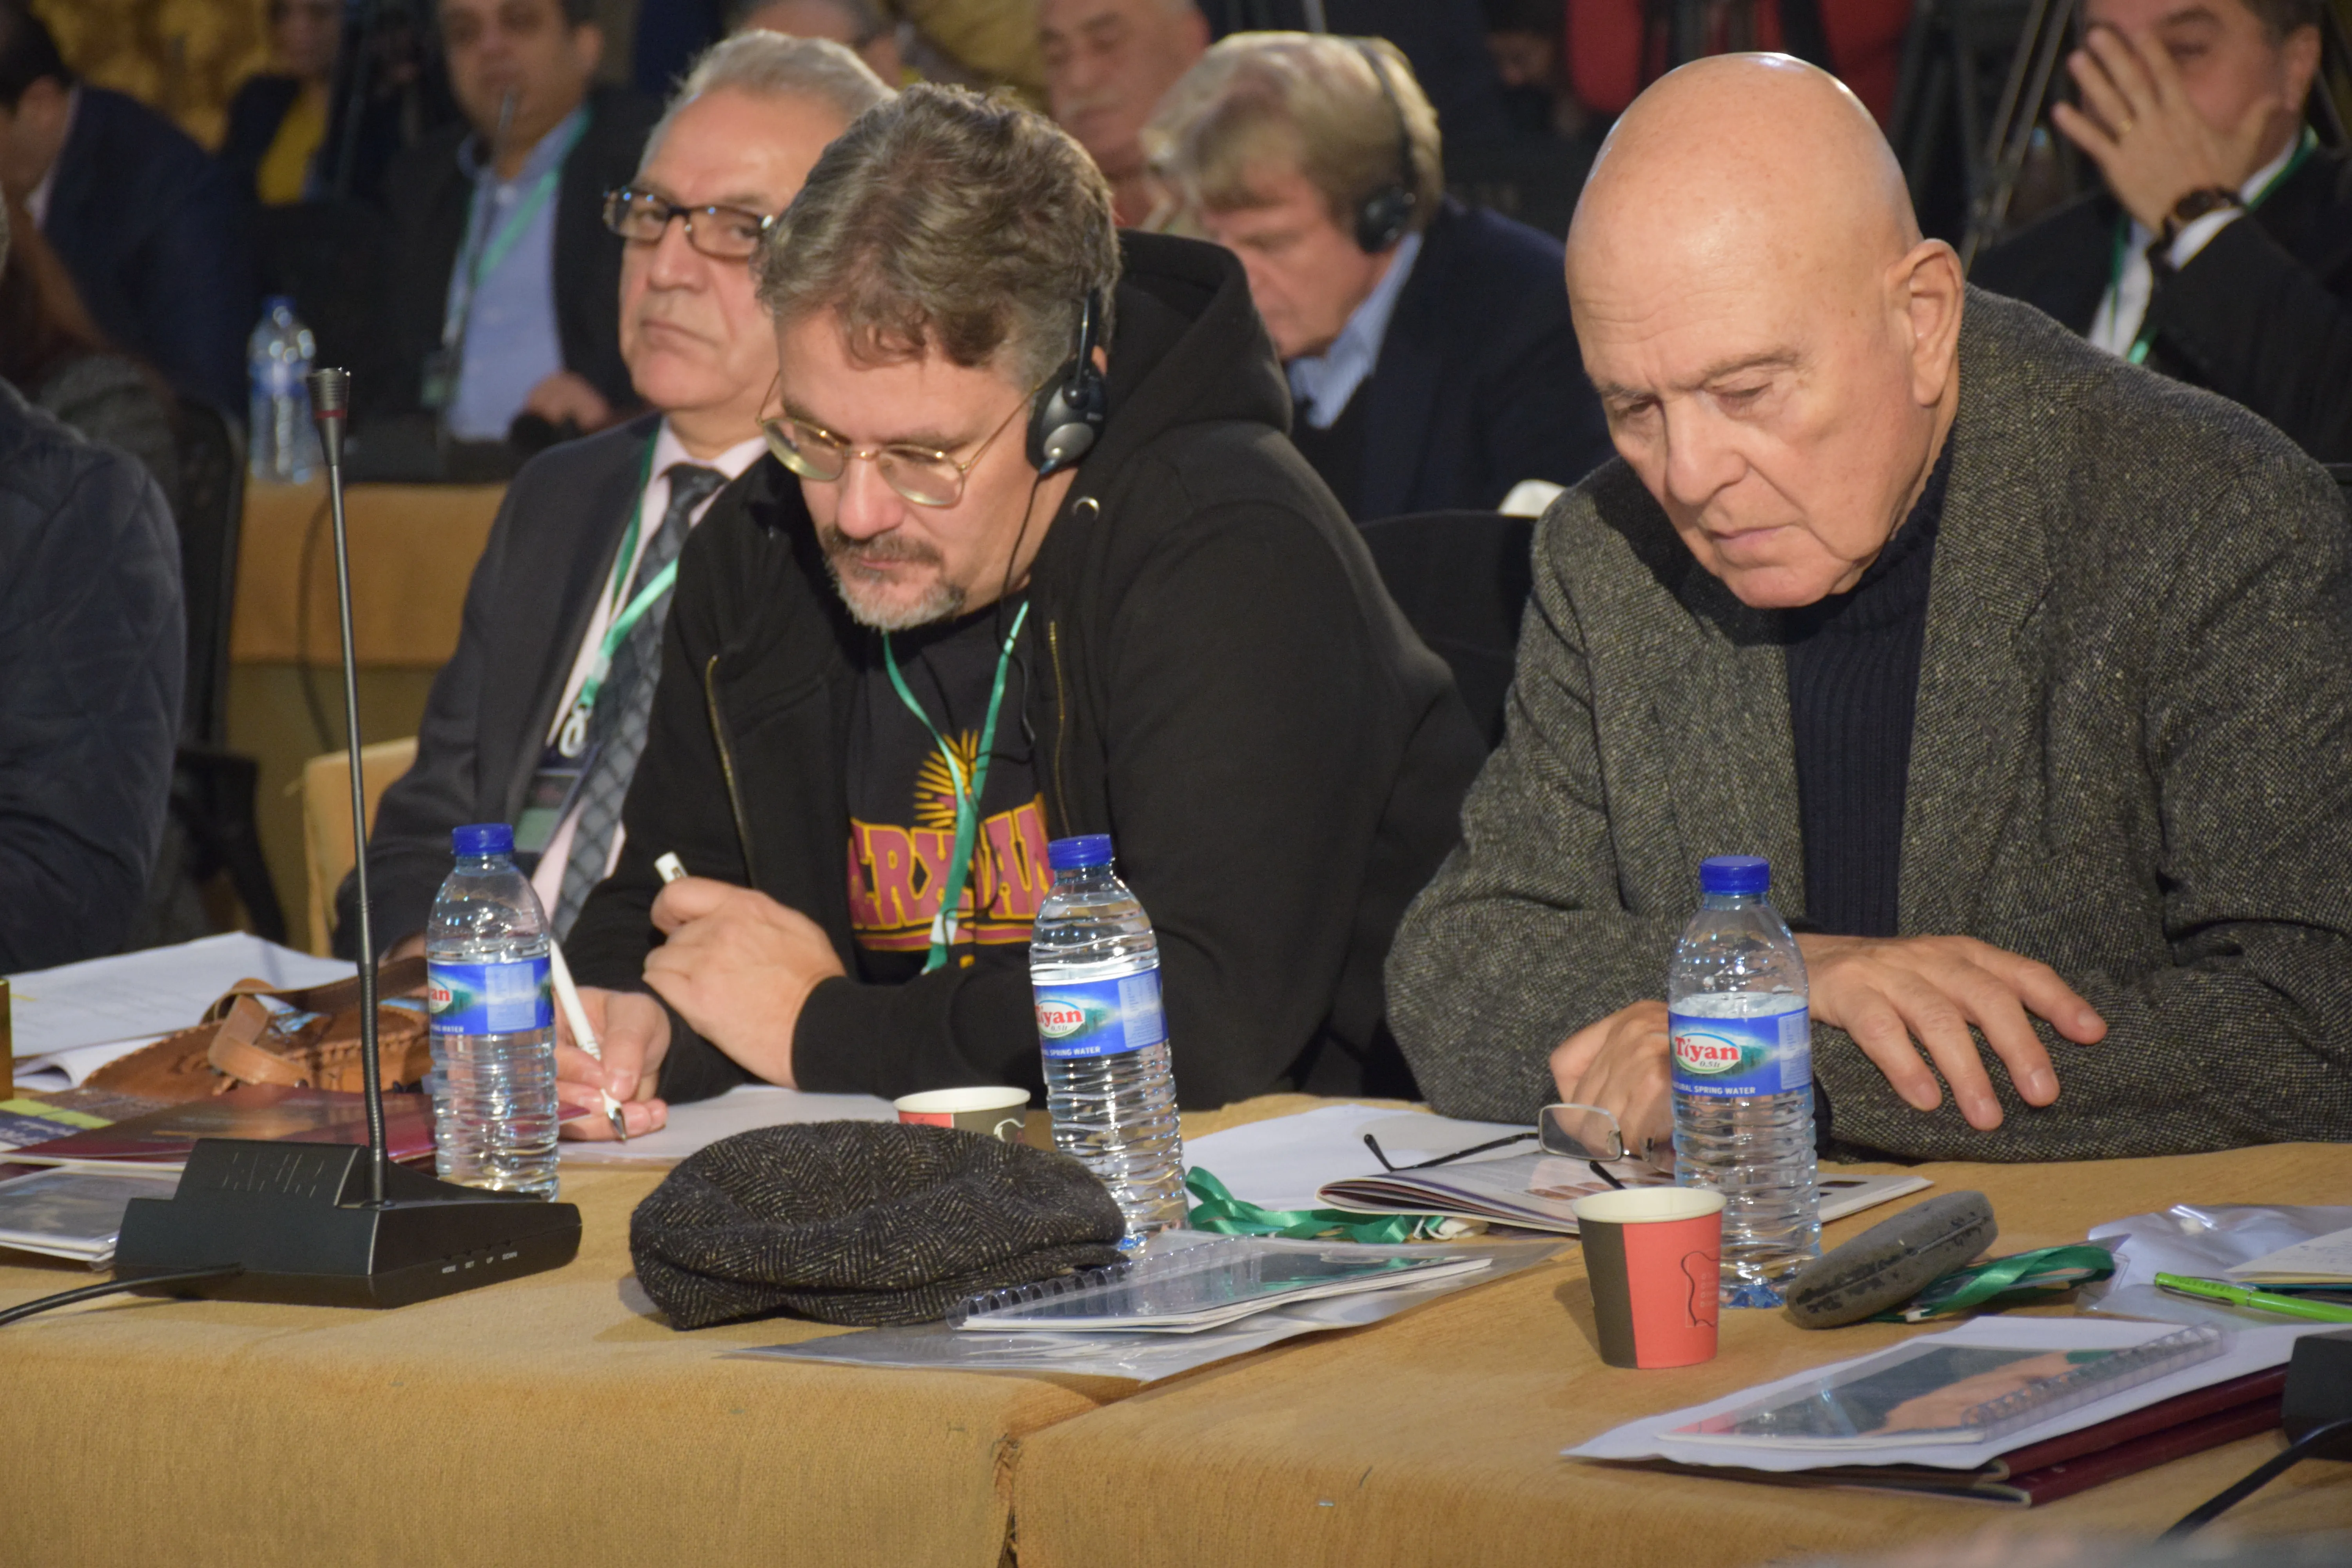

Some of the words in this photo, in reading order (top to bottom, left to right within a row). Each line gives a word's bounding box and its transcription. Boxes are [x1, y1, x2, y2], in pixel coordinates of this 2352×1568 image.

[1050, 1048, 1073, 1056] SPRING
[1073, 1046, 1101, 1056] WATER
[1675, 1036, 1739, 1062] Tiyan
[1694, 1085, 1723, 1095] SPRING
[1725, 1087, 1756, 1095] WATER
